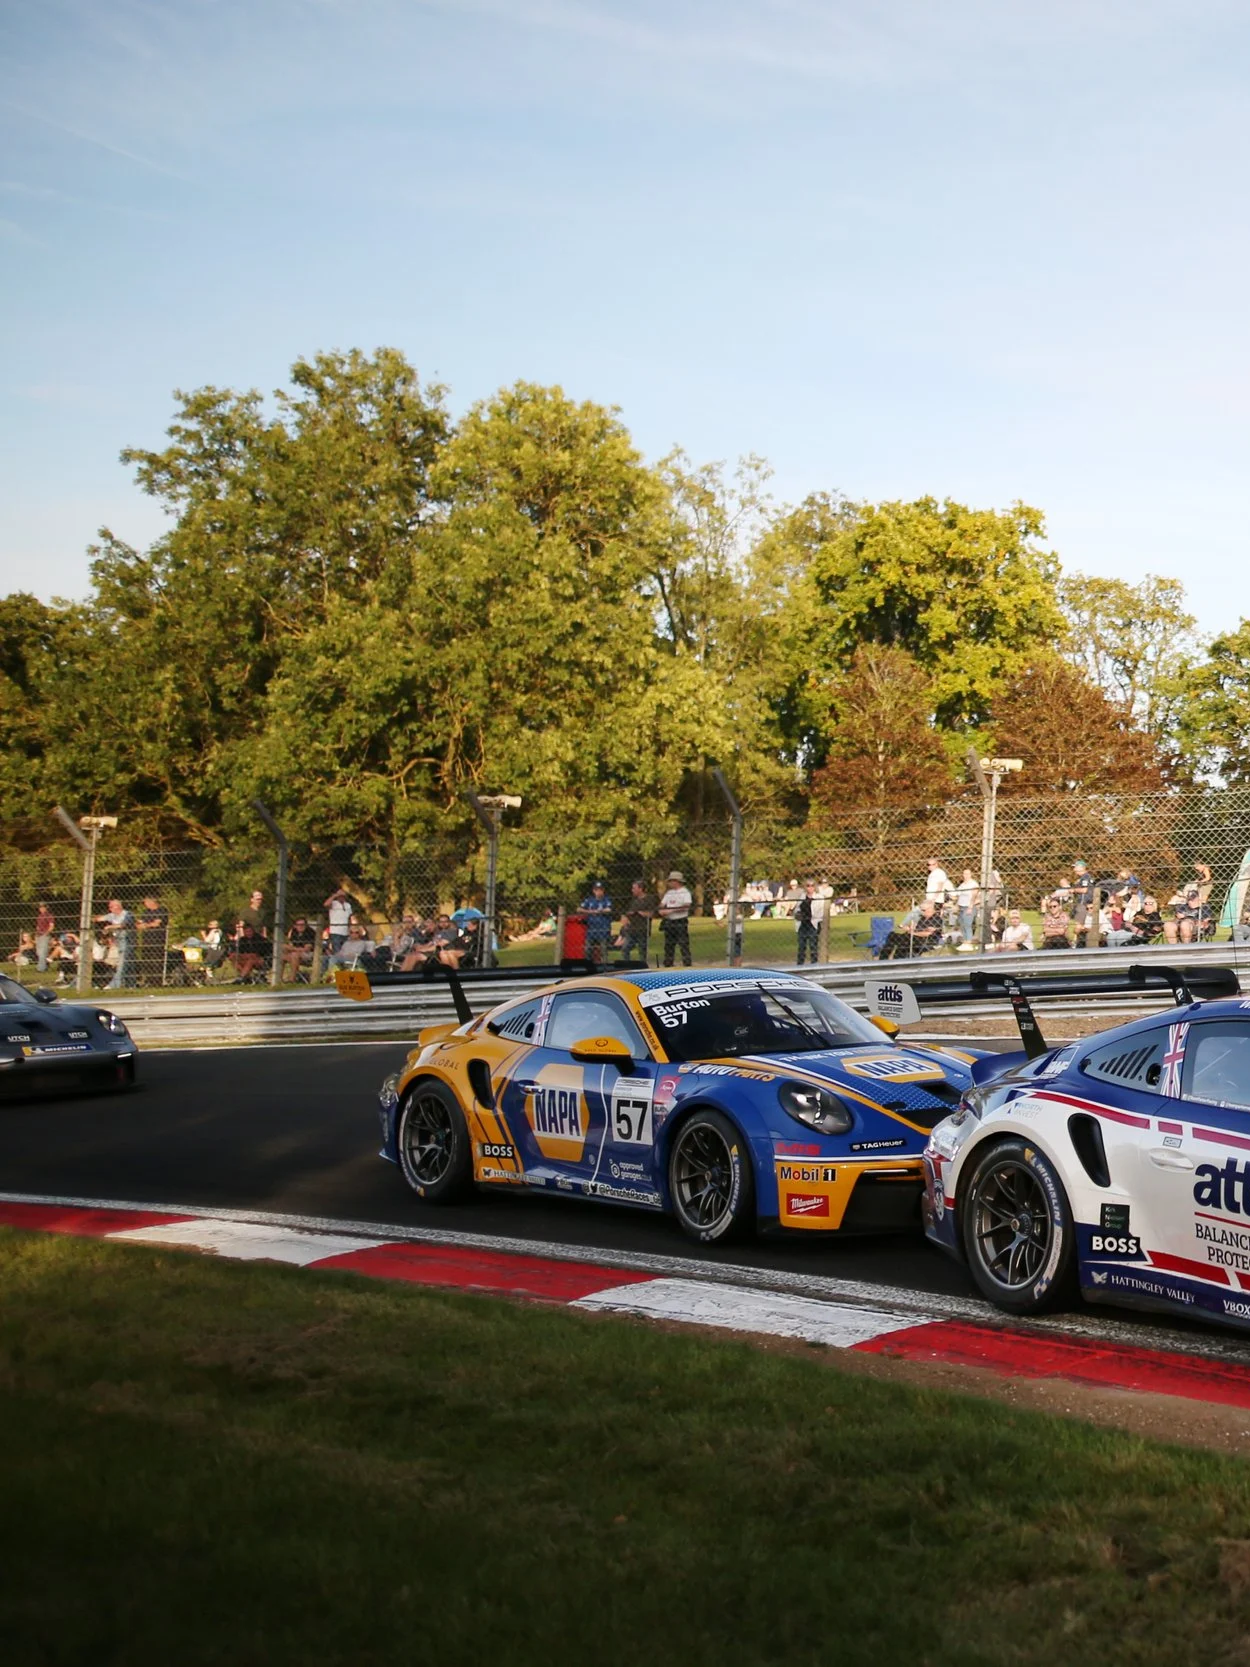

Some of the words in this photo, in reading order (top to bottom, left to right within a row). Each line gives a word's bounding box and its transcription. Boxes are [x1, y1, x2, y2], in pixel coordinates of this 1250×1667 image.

[665, 981, 817, 997] PORSCHE
[878, 985, 903, 1002] attis
[652, 999, 711, 1017] Burton
[660, 1012, 688, 1028] 57
[853, 1059, 935, 1076] NAPA
[533, 1089, 581, 1136] NAPA
[616, 1099, 649, 1141] 57
[484, 1144, 513, 1157] BOSS
[780, 1166, 819, 1181] Mobil
[1036, 1162, 1061, 1221] MICHELIN
[1092, 1236, 1138, 1254] BOSS
[1111, 1275, 1165, 1295] HATTINGLEY
[1166, 1287, 1196, 1303] VALLEY
[1223, 1299, 1250, 1315] VBOX
